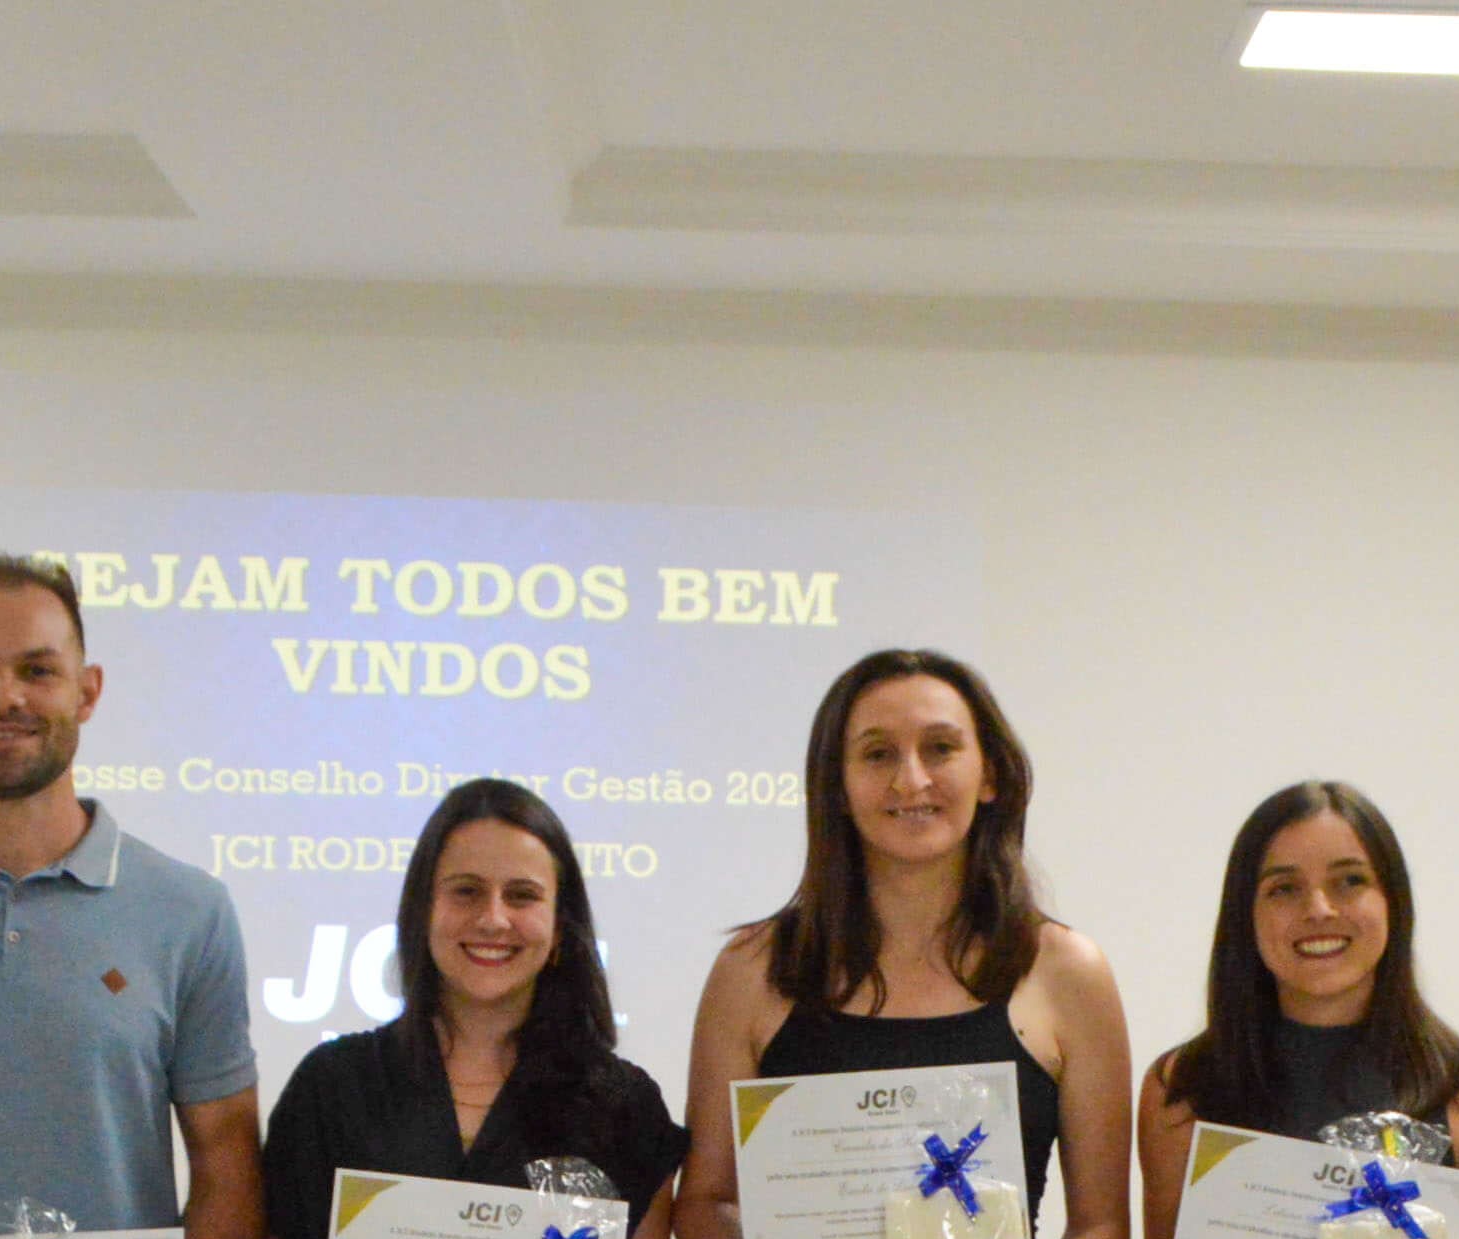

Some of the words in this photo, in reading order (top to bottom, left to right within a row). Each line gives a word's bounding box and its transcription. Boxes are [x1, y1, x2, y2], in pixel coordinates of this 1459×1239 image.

[339, 558, 629, 621] TODOS
[657, 567, 840, 627] BEM
[271, 637, 591, 701] VINDOS
[72, 762, 165, 791] osse
[178, 758, 384, 795] Conselho
[563, 767, 713, 804] Gestão
[726, 771, 807, 806] 202
[210, 834, 277, 875] JCI
[289, 837, 418, 872] RODE
[263, 924, 406, 1023] JC
[856, 1089, 898, 1110] JCI
[1313, 1163, 1356, 1187] JCI
[459, 1201, 502, 1223] JCI
